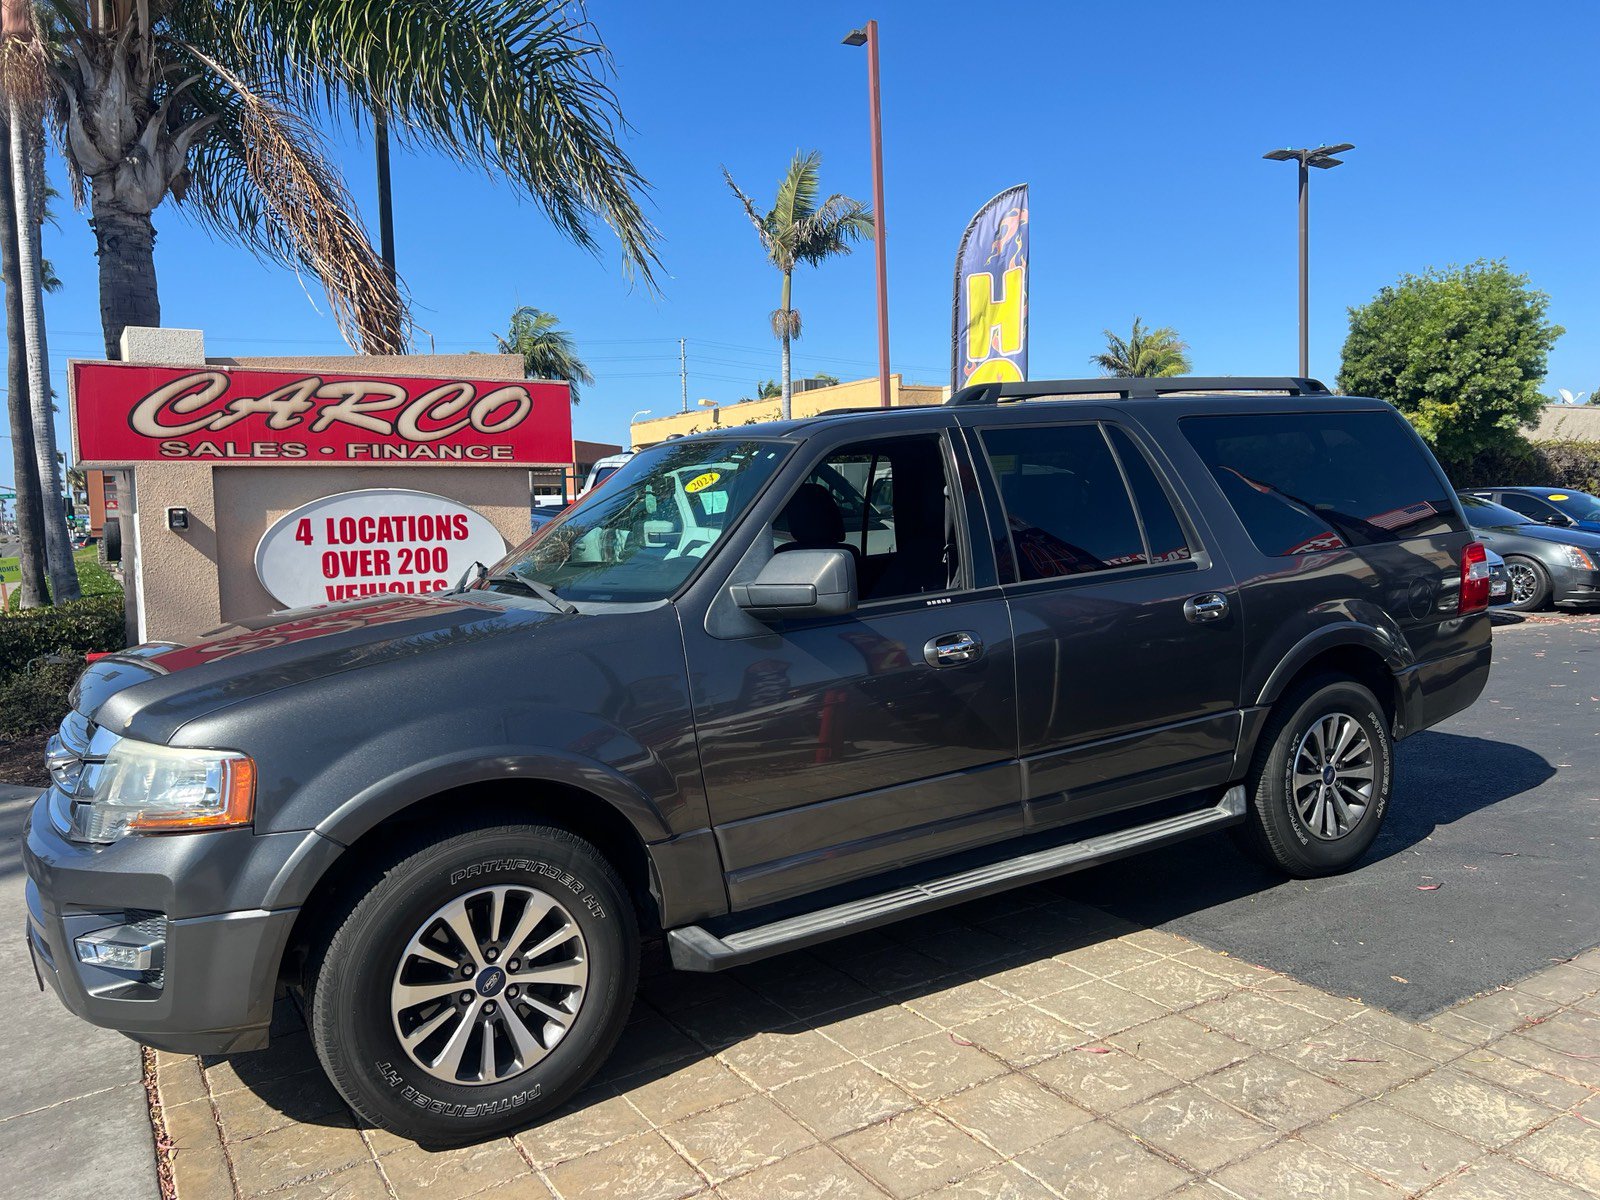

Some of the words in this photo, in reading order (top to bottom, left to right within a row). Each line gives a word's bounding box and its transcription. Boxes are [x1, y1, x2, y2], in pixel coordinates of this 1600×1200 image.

[128, 371, 533, 441] CARCO
[160, 441, 307, 459] SALES
[346, 444, 513, 460] FINANCE
[295, 518, 314, 546] 4
[326, 514, 469, 545] LOCATIONS
[321, 549, 391, 579] OVER
[397, 546, 448, 575] 200
[450, 858, 585, 895] PATHFINDER
[582, 893, 607, 919] HT
[375, 1060, 403, 1087] HT
[401, 1083, 542, 1117] PATHFINDER
